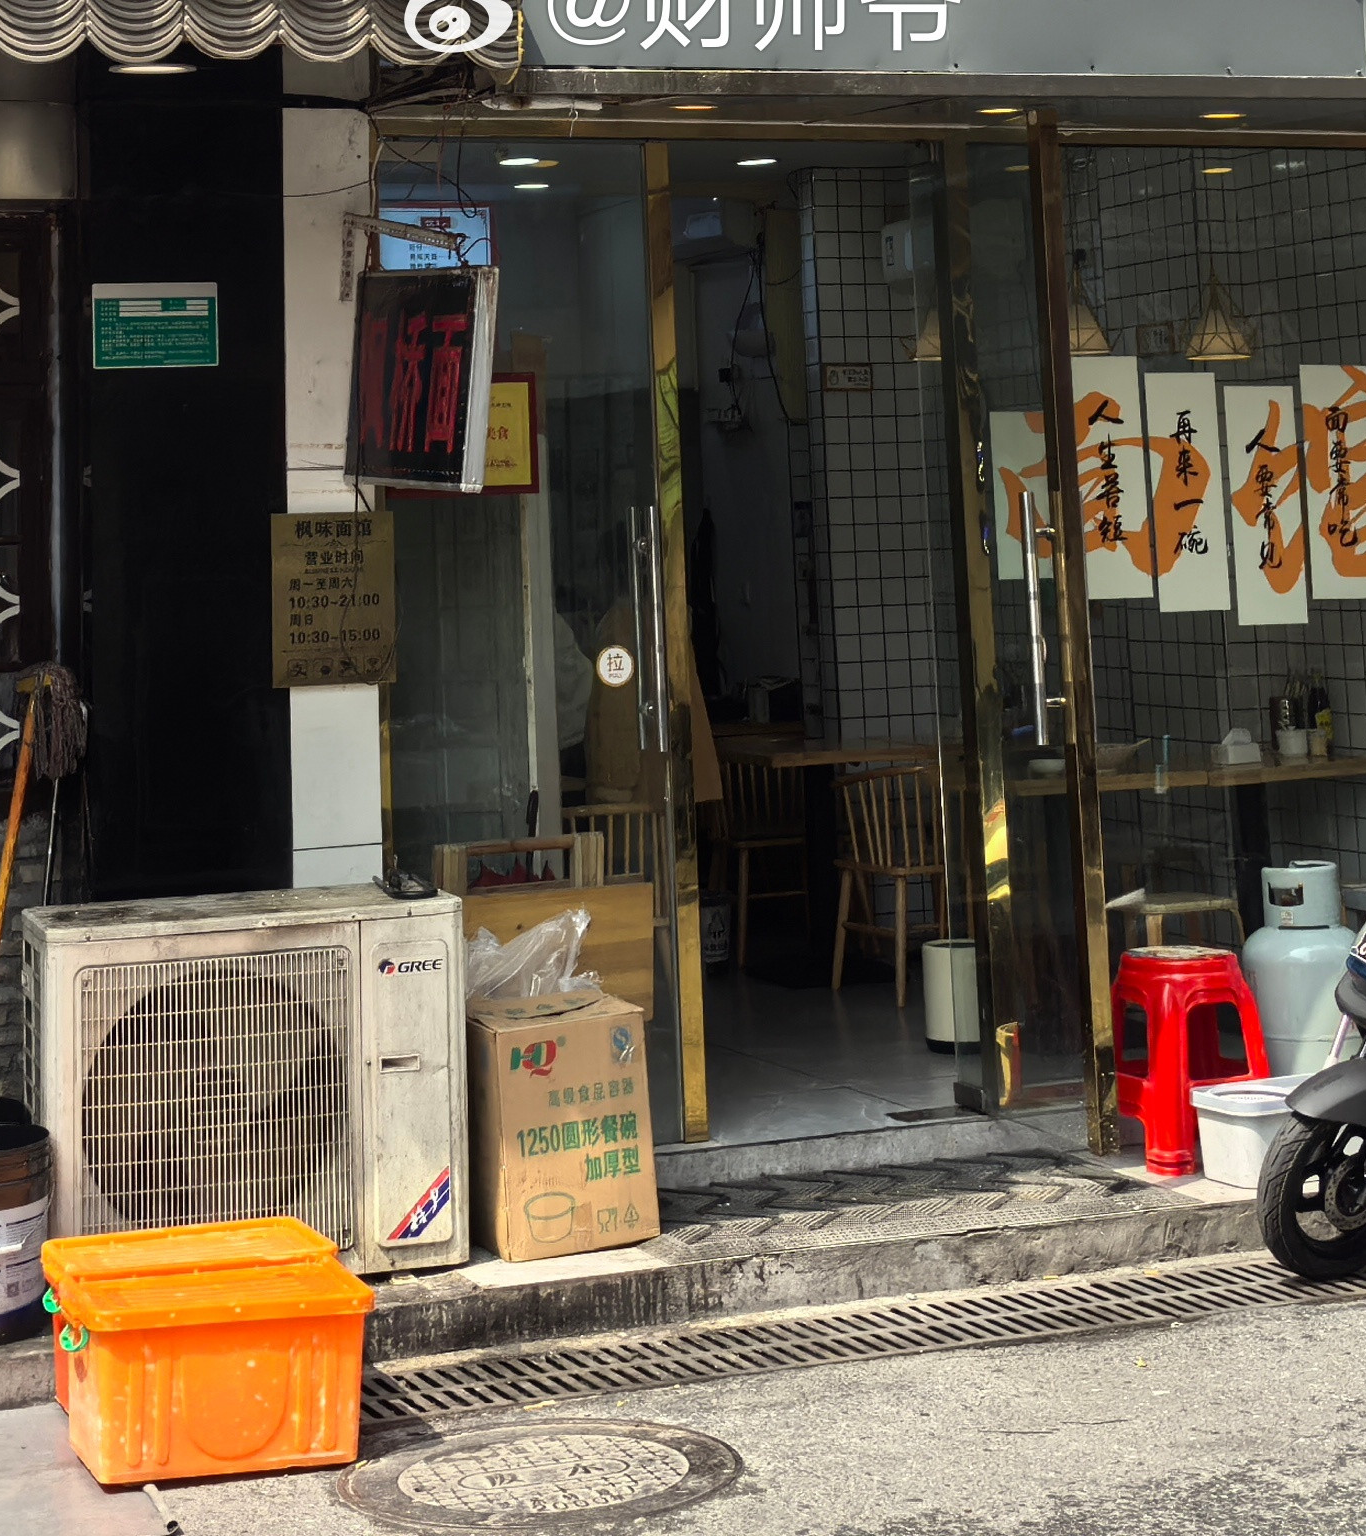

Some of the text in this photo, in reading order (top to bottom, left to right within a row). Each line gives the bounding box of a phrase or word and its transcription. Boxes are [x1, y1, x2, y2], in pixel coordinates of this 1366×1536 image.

[1169, 409, 1209, 556] 再来一碗
[295, 519, 372, 540] 枫味面馆
[304, 549, 364, 566] 营业时间
[288, 576, 354, 591] 周一至周六
[289, 614, 314, 627] 周日
[607, 653, 625, 672] 拉
[398, 958, 443, 974] GREE
[510, 1039, 557, 1077] HQ
[548, 1076, 635, 1108] 高级食品容器
[516, 1110, 639, 1159] 1250圆形餐碗
[584, 1144, 642, 1183] 加厚型
